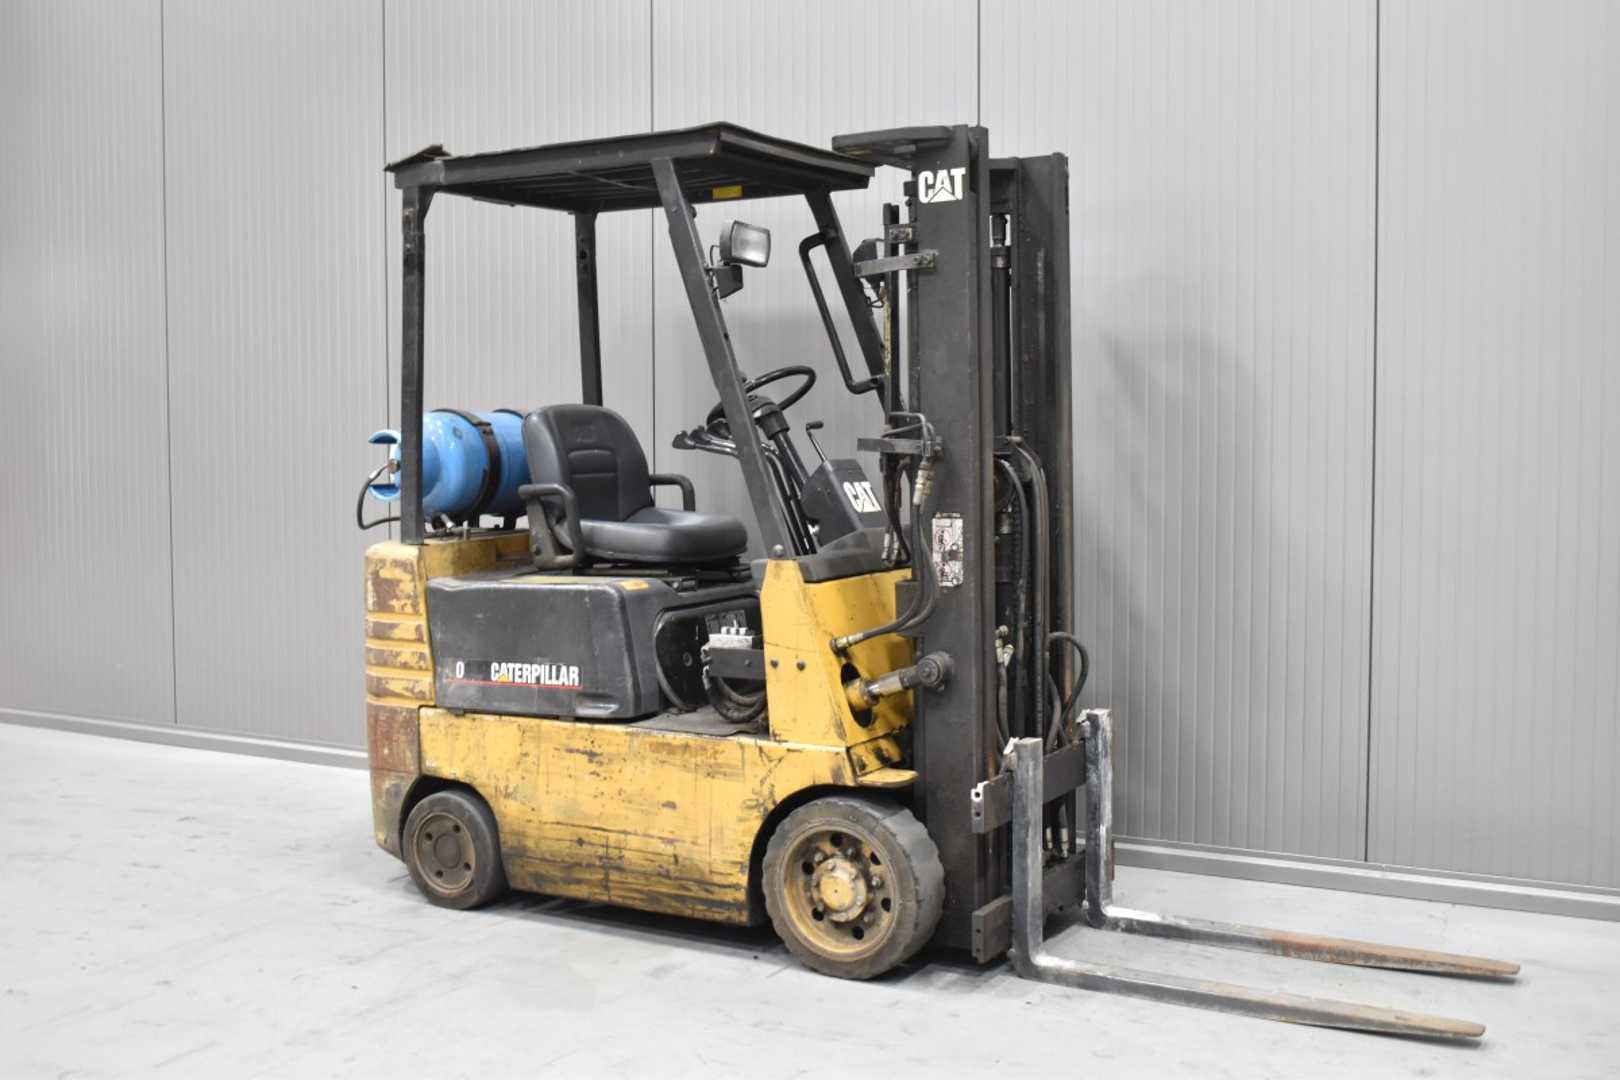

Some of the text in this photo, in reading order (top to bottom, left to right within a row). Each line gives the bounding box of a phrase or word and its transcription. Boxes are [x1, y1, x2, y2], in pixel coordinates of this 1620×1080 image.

[918, 167, 966, 203] CAT
[843, 481, 881, 512] CAT
[490, 662, 580, 686] CATERPILLAR
